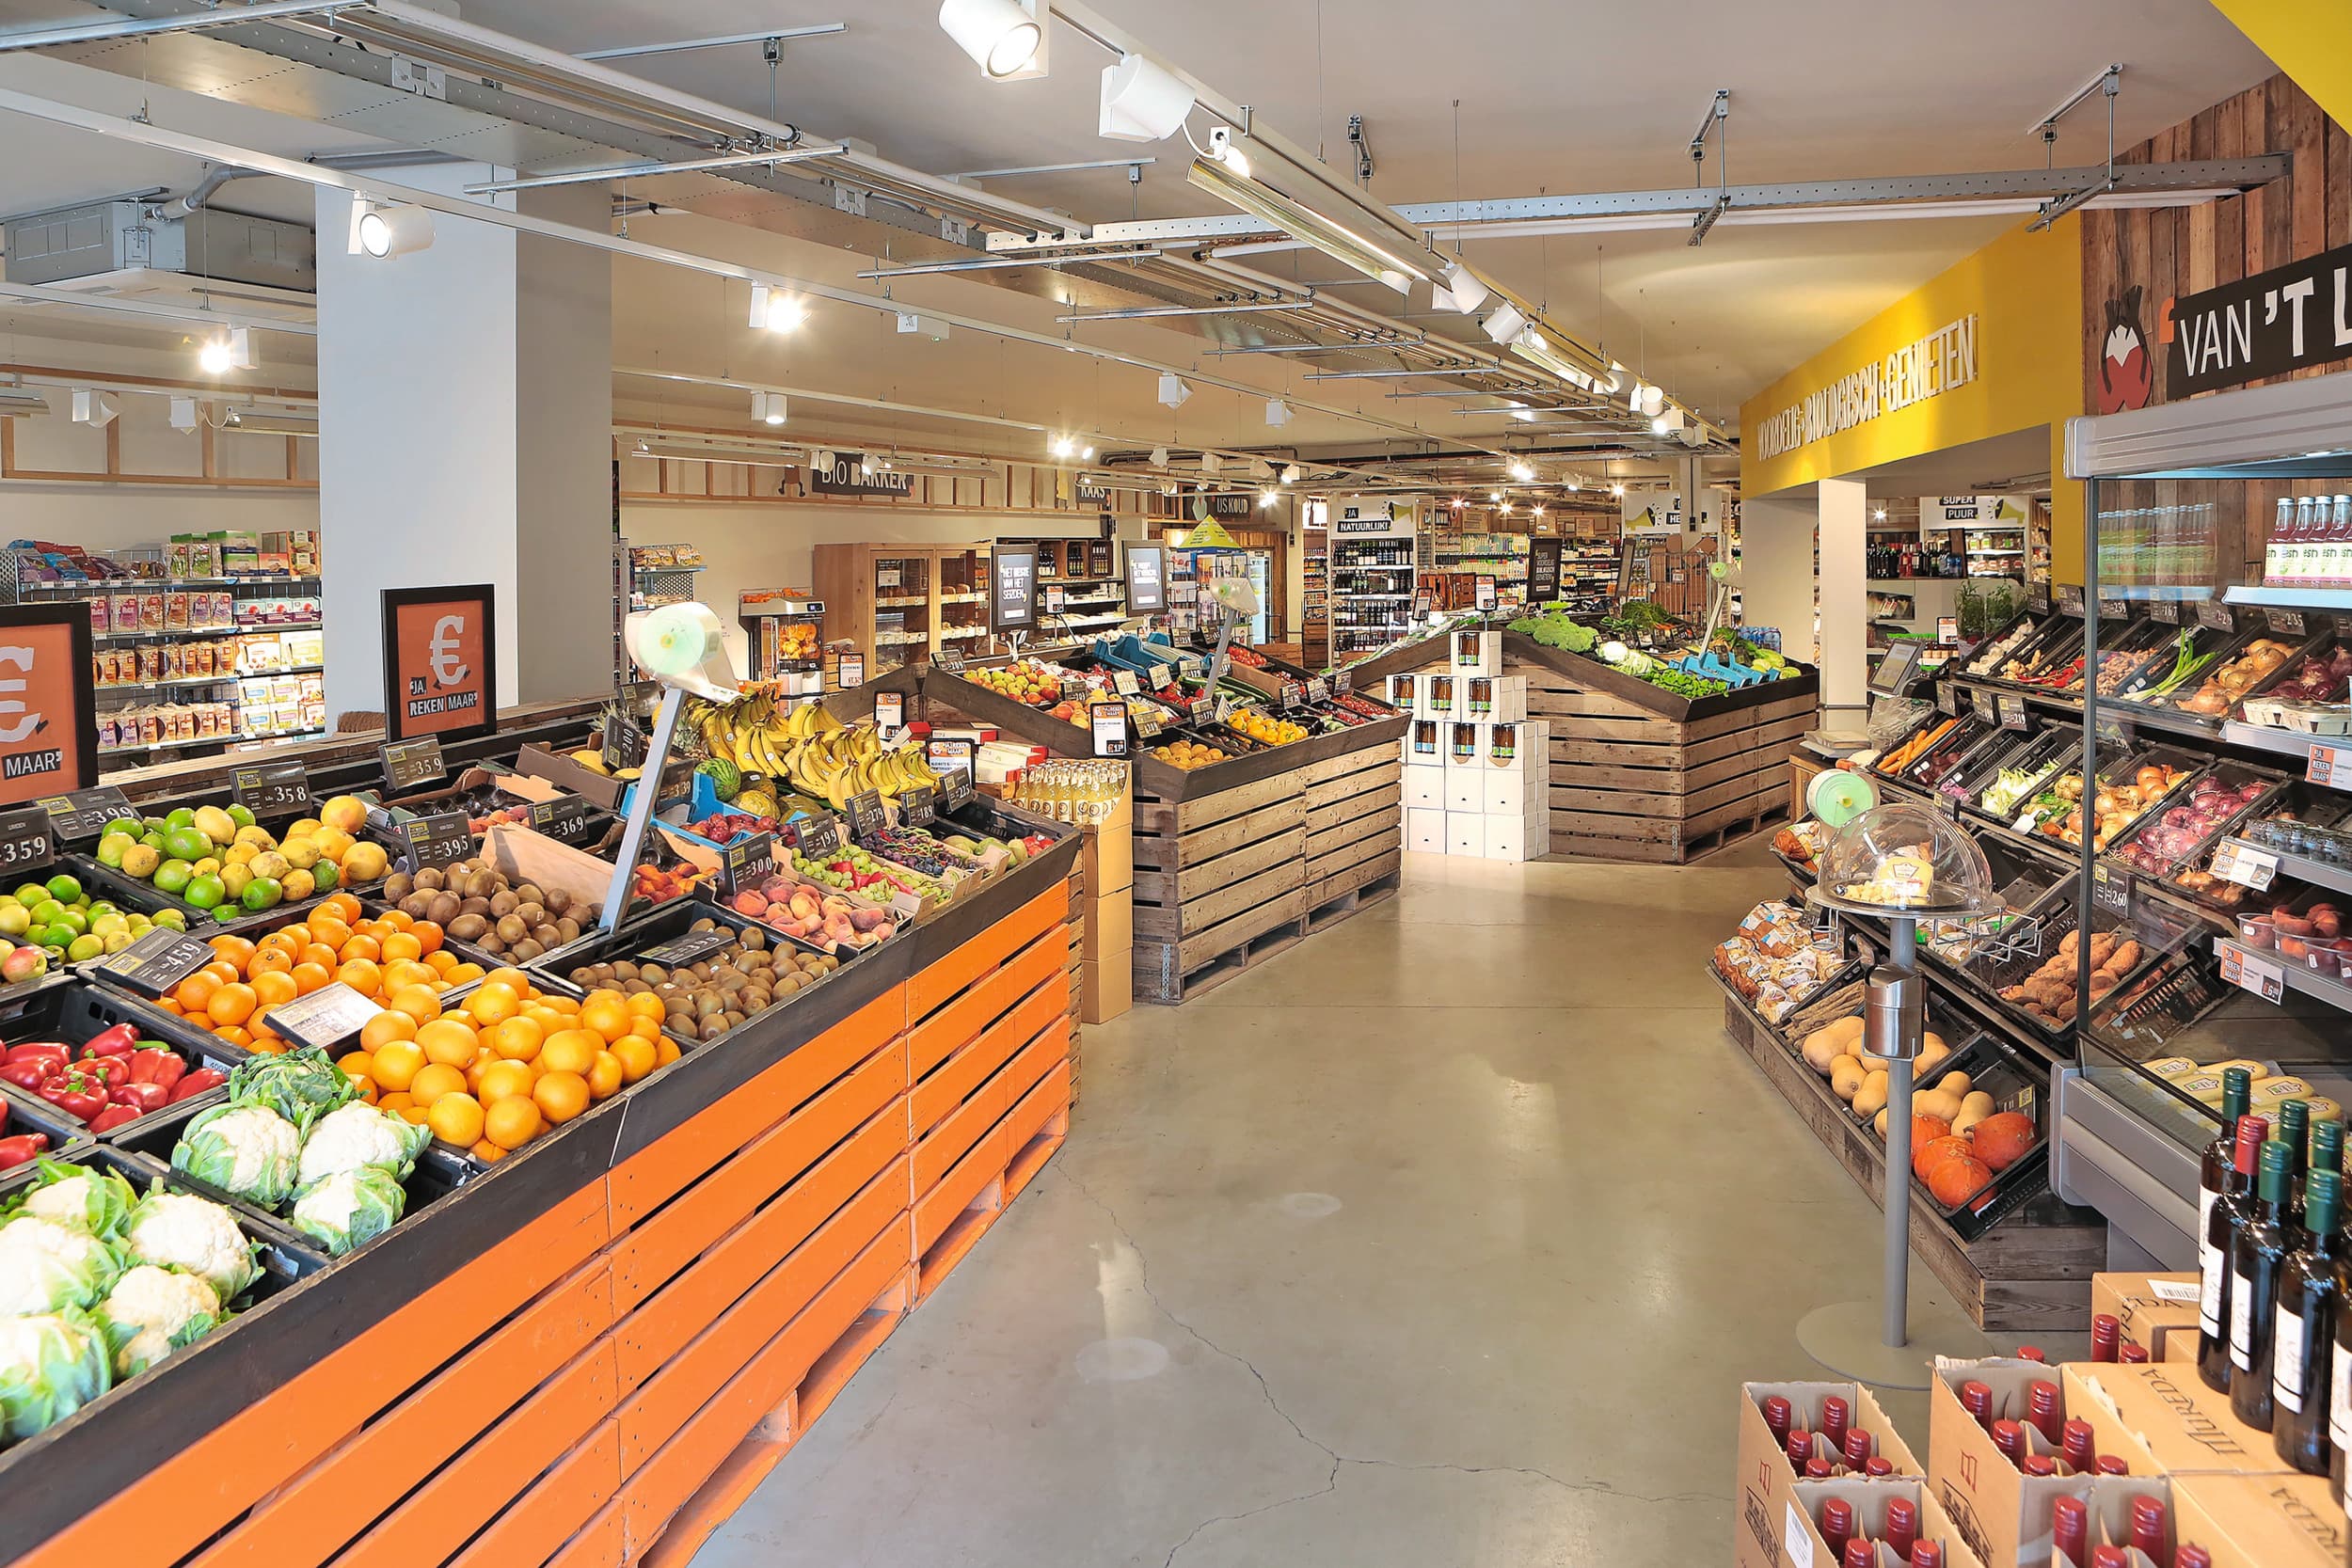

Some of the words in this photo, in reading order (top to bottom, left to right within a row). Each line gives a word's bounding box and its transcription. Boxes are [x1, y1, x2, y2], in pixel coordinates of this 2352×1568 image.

[2180, 299, 2250, 377] VAN
[1756, 404, 1801, 462] VOORDELIG
[1804, 360, 1881, 445] BIOLOGISCH
[1885, 313, 1977, 412] GENIETEN
[850, 462, 907, 490] BAKKER
[1943, 496, 1973, 505] SUPER
[1947, 509, 1974, 519] PUUR
[409, 698, 445, 717] REKEN
[623, 728, 634, 752] 200
[416, 757, 443, 775] 359
[274, 786, 307, 803] 358
[675, 781, 691, 796] 339
[91, 806, 135, 824] 399
[869, 807, 883, 823] 279
[919, 807, 933, 820] 189
[561, 815, 584, 836] 369
[441, 834, 469, 858] 395
[819, 829, 837, 848] 199
[4, 836, 46, 863] 359
[751, 856, 773, 878] 300
[166, 942, 203, 966] 459
